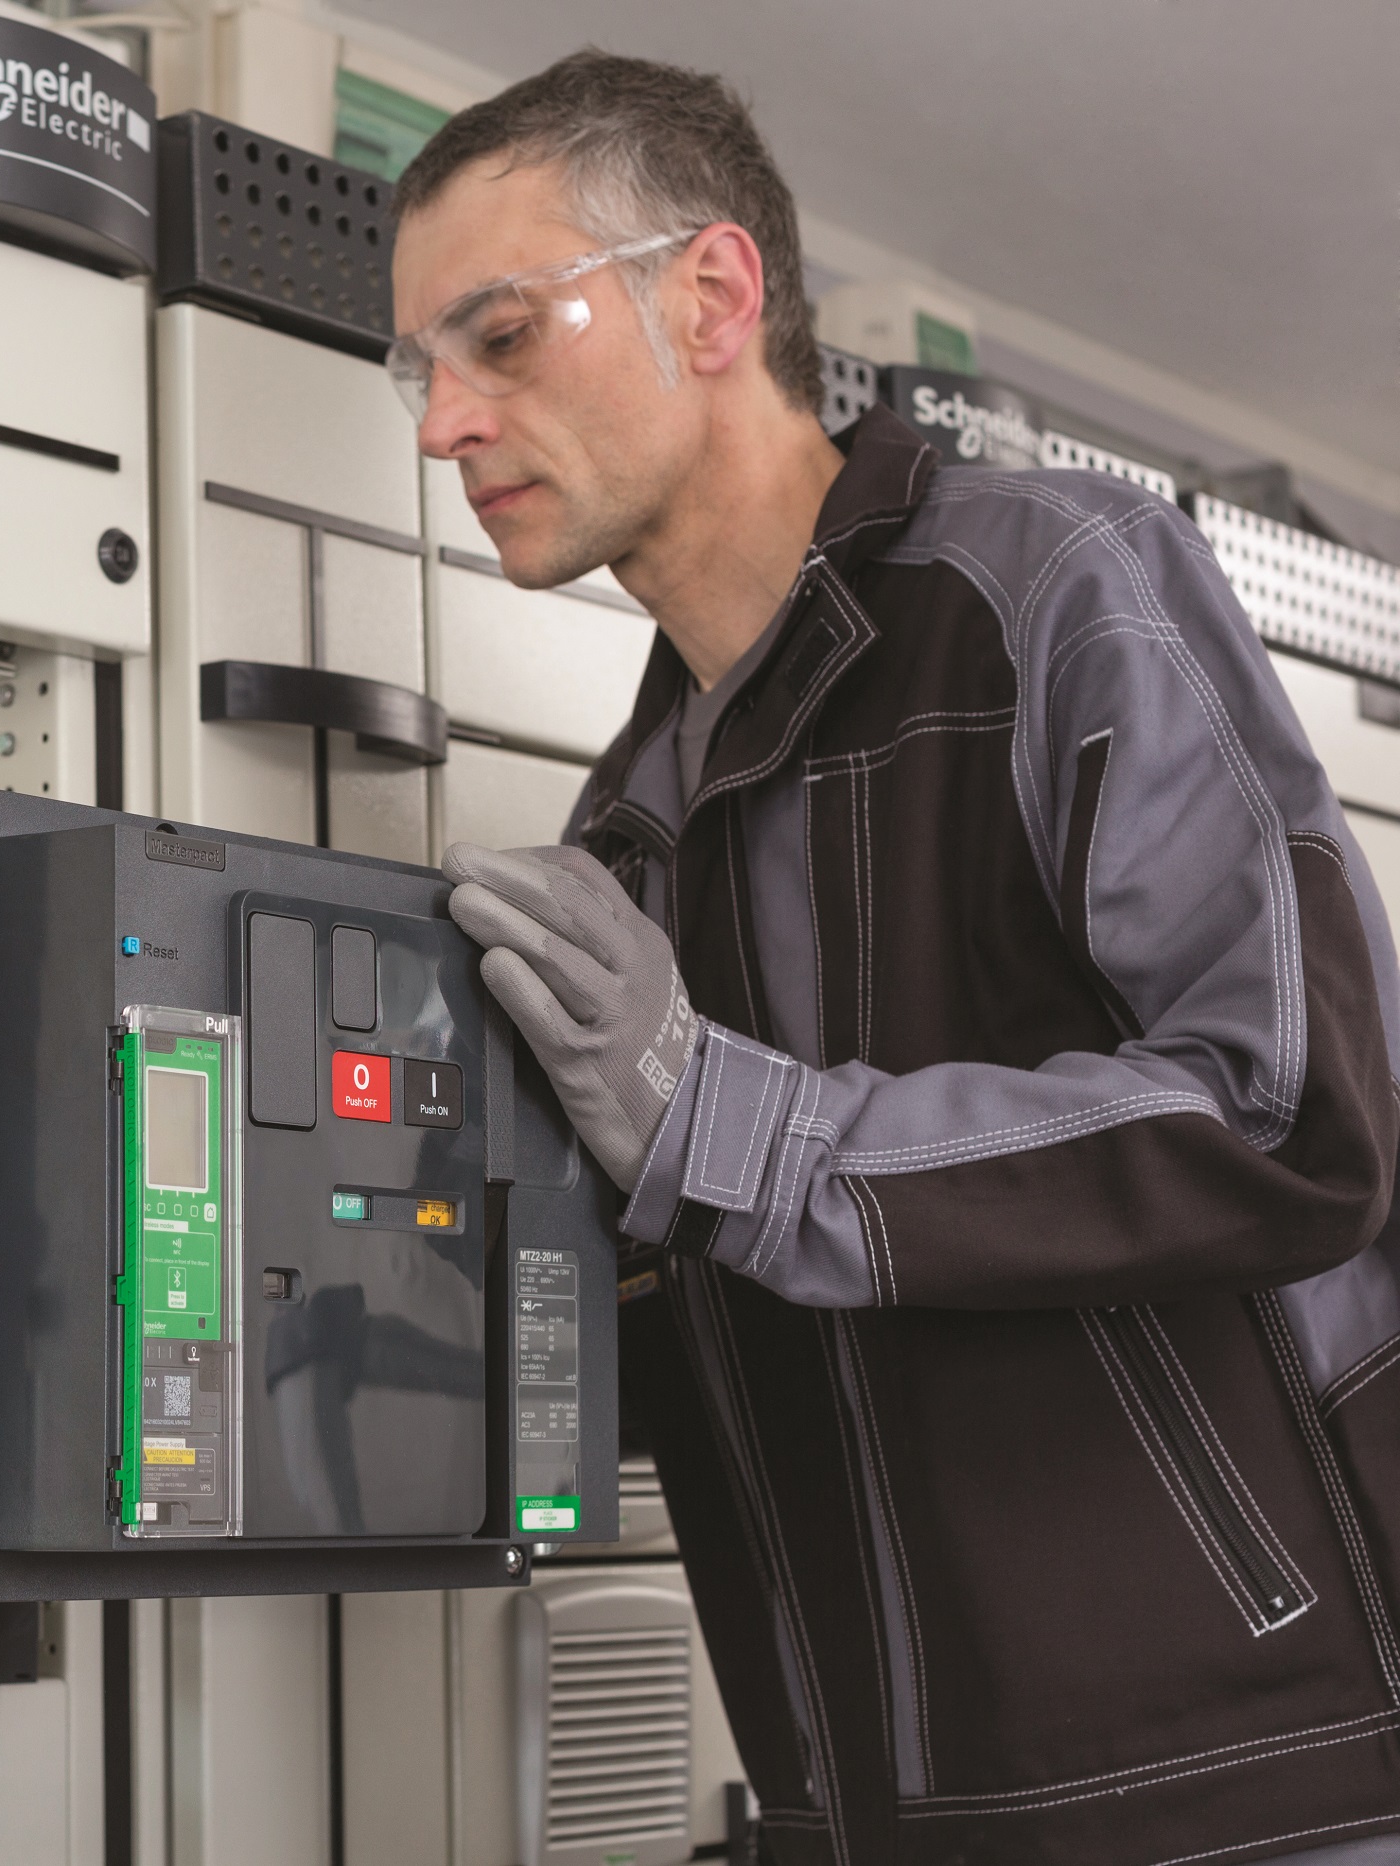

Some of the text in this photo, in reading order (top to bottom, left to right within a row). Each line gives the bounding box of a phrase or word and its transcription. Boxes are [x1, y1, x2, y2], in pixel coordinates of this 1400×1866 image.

[21, 96, 122, 161] Electric
[151, 838, 220, 864] Masterpact
[129, 939, 179, 960] R Reset
[205, 1016, 228, 1034] Pull
[345, 1095, 377, 1109] Push OFF
[420, 1104, 448, 1116] Push ON
[346, 1197, 361, 1209] OFF
[430, 1215, 441, 1225] OK
[520, 1250, 562, 1263] MTZ2-20 H1
[200, 1484, 211, 1492] VPS
[522, 1500, 553, 1508] IP ADDRESS
